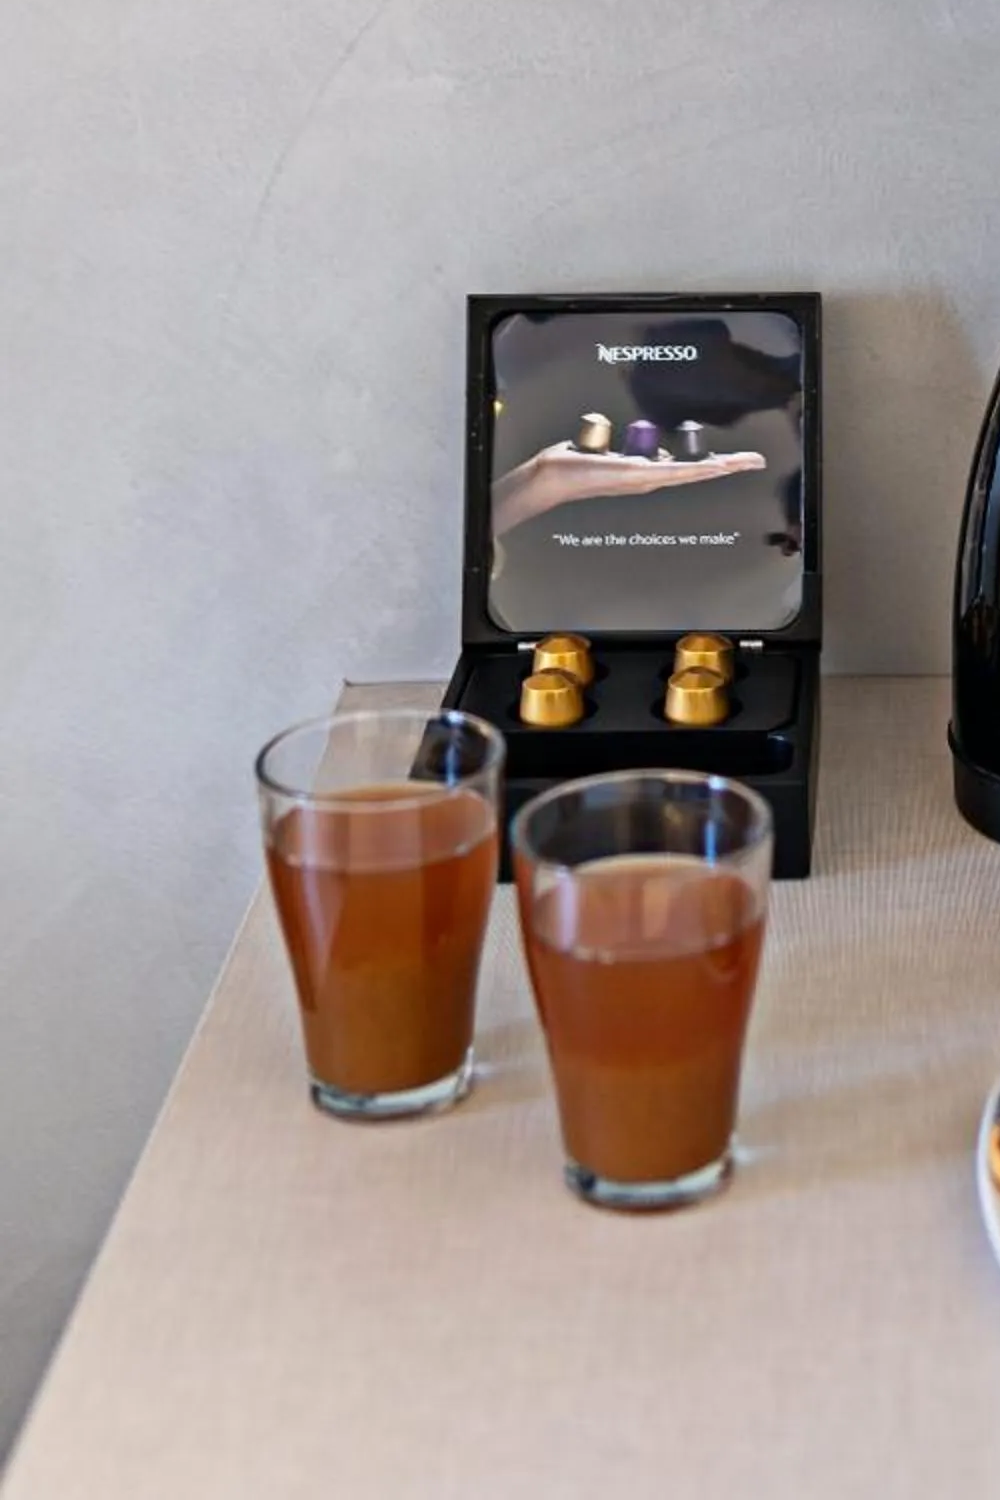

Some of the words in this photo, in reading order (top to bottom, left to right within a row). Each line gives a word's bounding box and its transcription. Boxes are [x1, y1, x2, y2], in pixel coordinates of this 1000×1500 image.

[596, 343, 698, 364] NESPRESSO
[582, 536, 602, 546] are
[604, 533, 626, 546] the
[628, 533, 677, 546] choices
[679, 536, 697, 546] we
